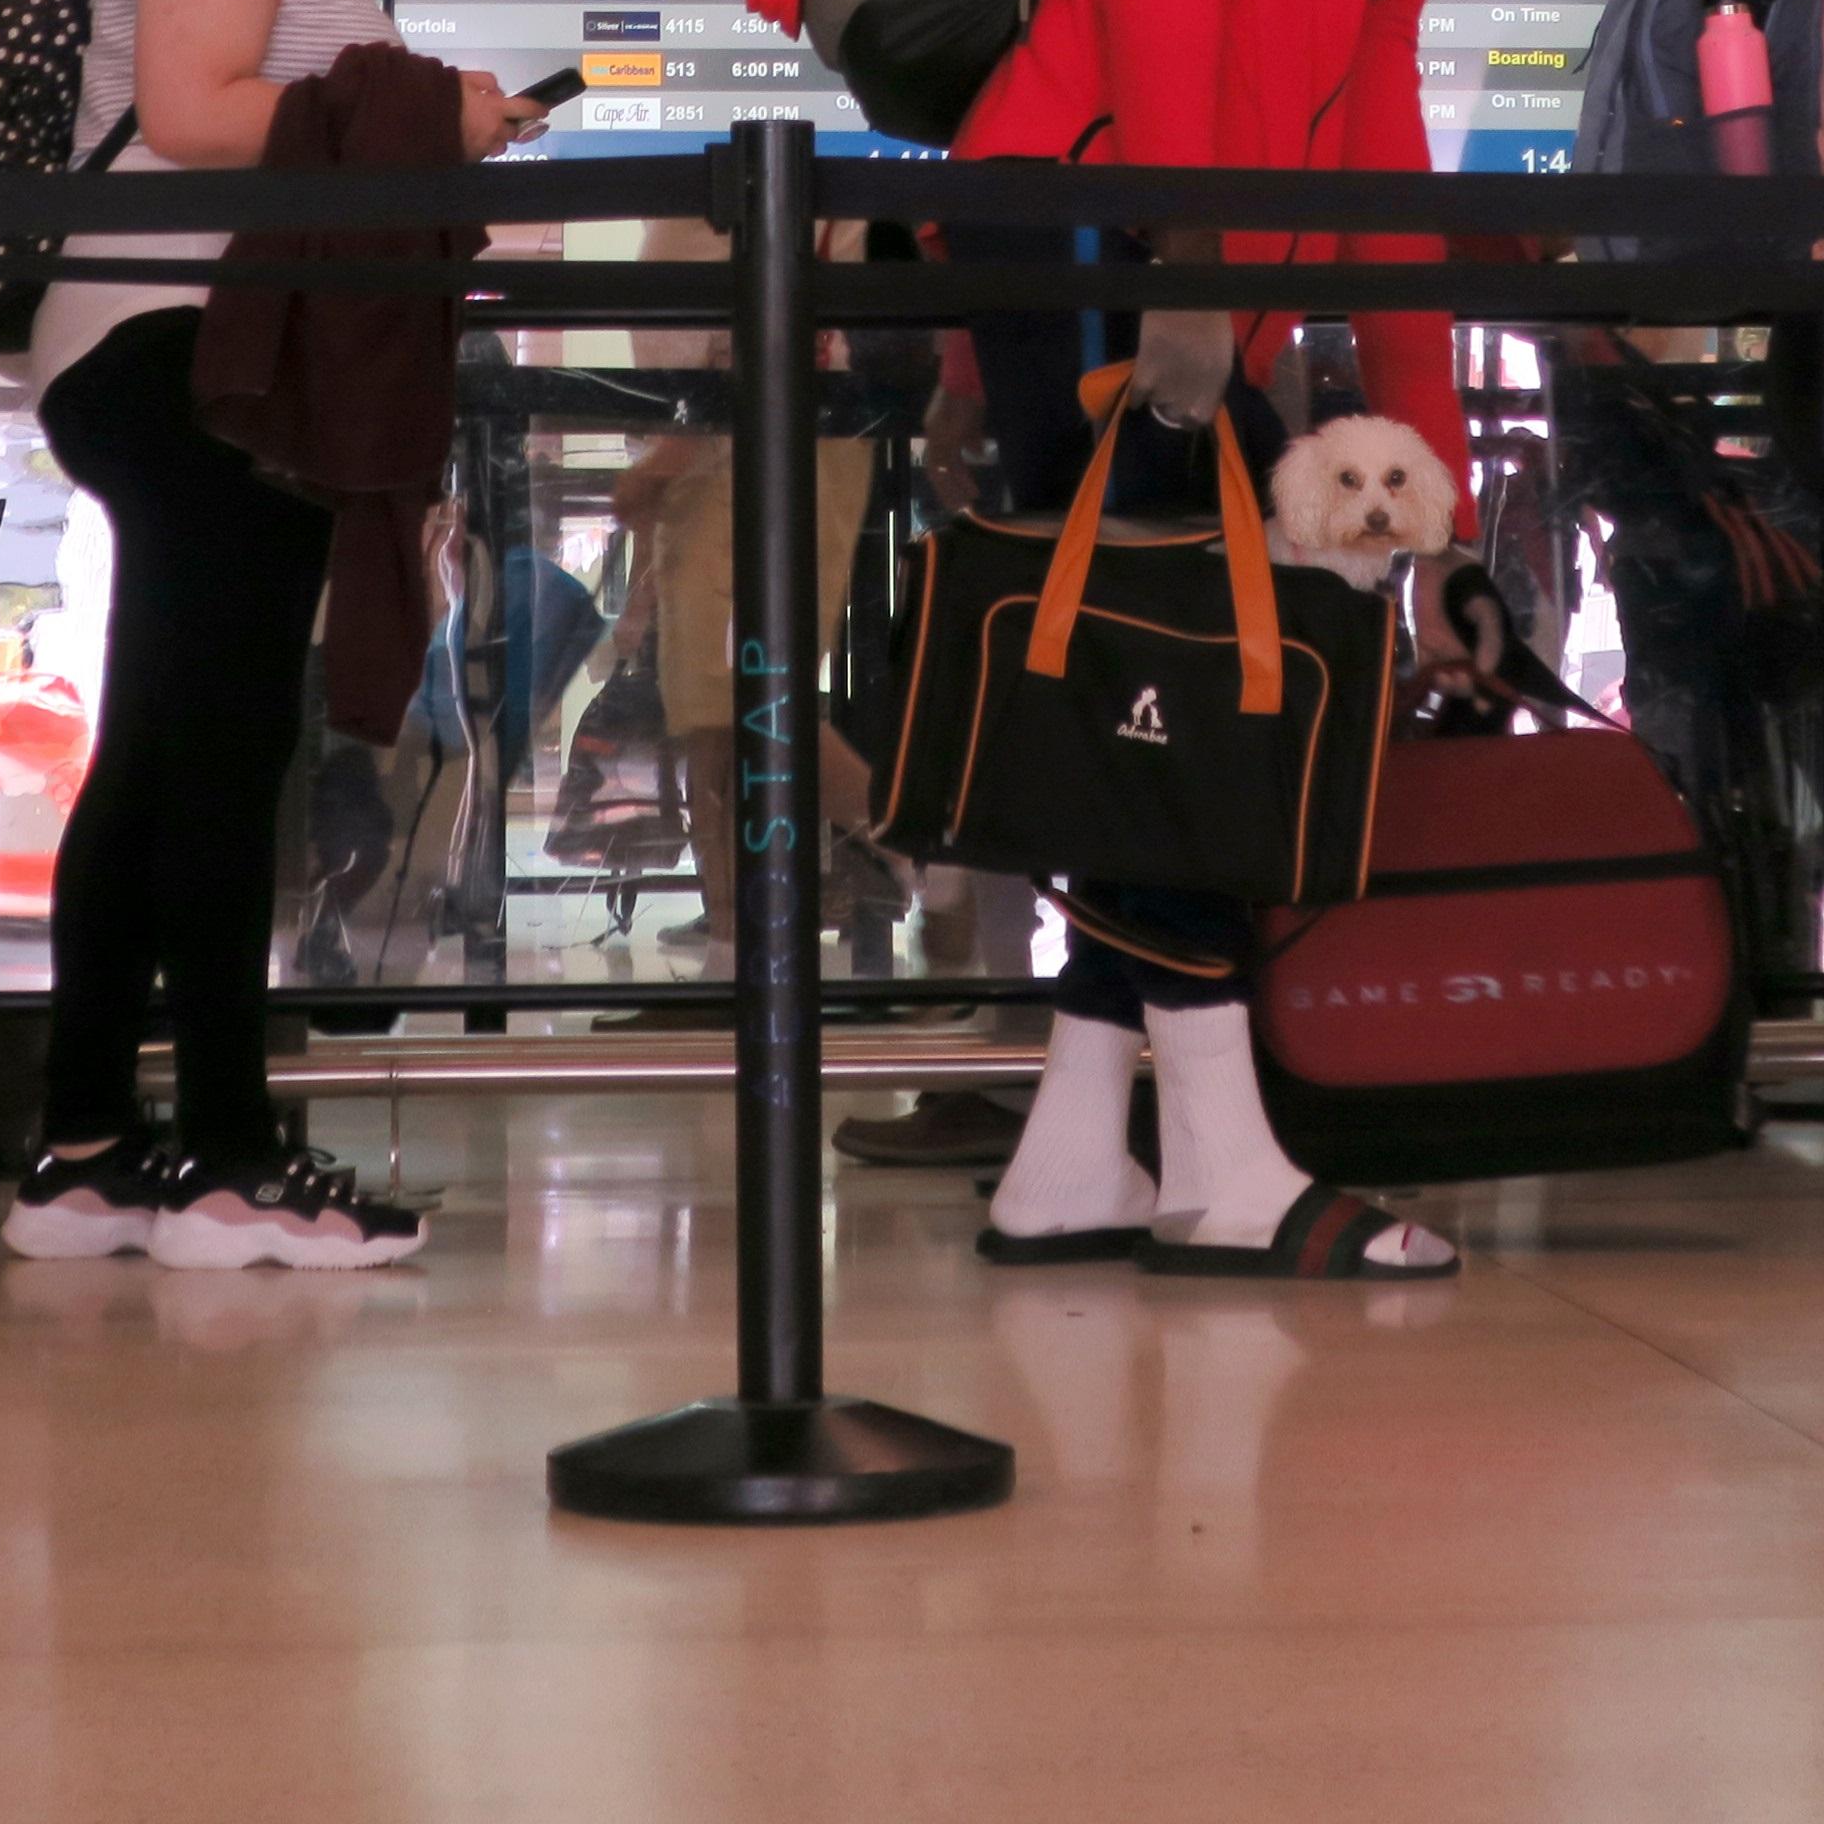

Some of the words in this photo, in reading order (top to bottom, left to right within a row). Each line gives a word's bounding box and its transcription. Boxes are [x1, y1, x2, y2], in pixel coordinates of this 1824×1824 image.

[1486, 49, 1566, 68] Boarding
[666, 62, 695, 77] 513
[732, 62, 768, 77] 6:00
[773, 62, 799, 77] PM
[1286, 981, 1420, 1010] GAME
[1521, 966, 1681, 995] READY
